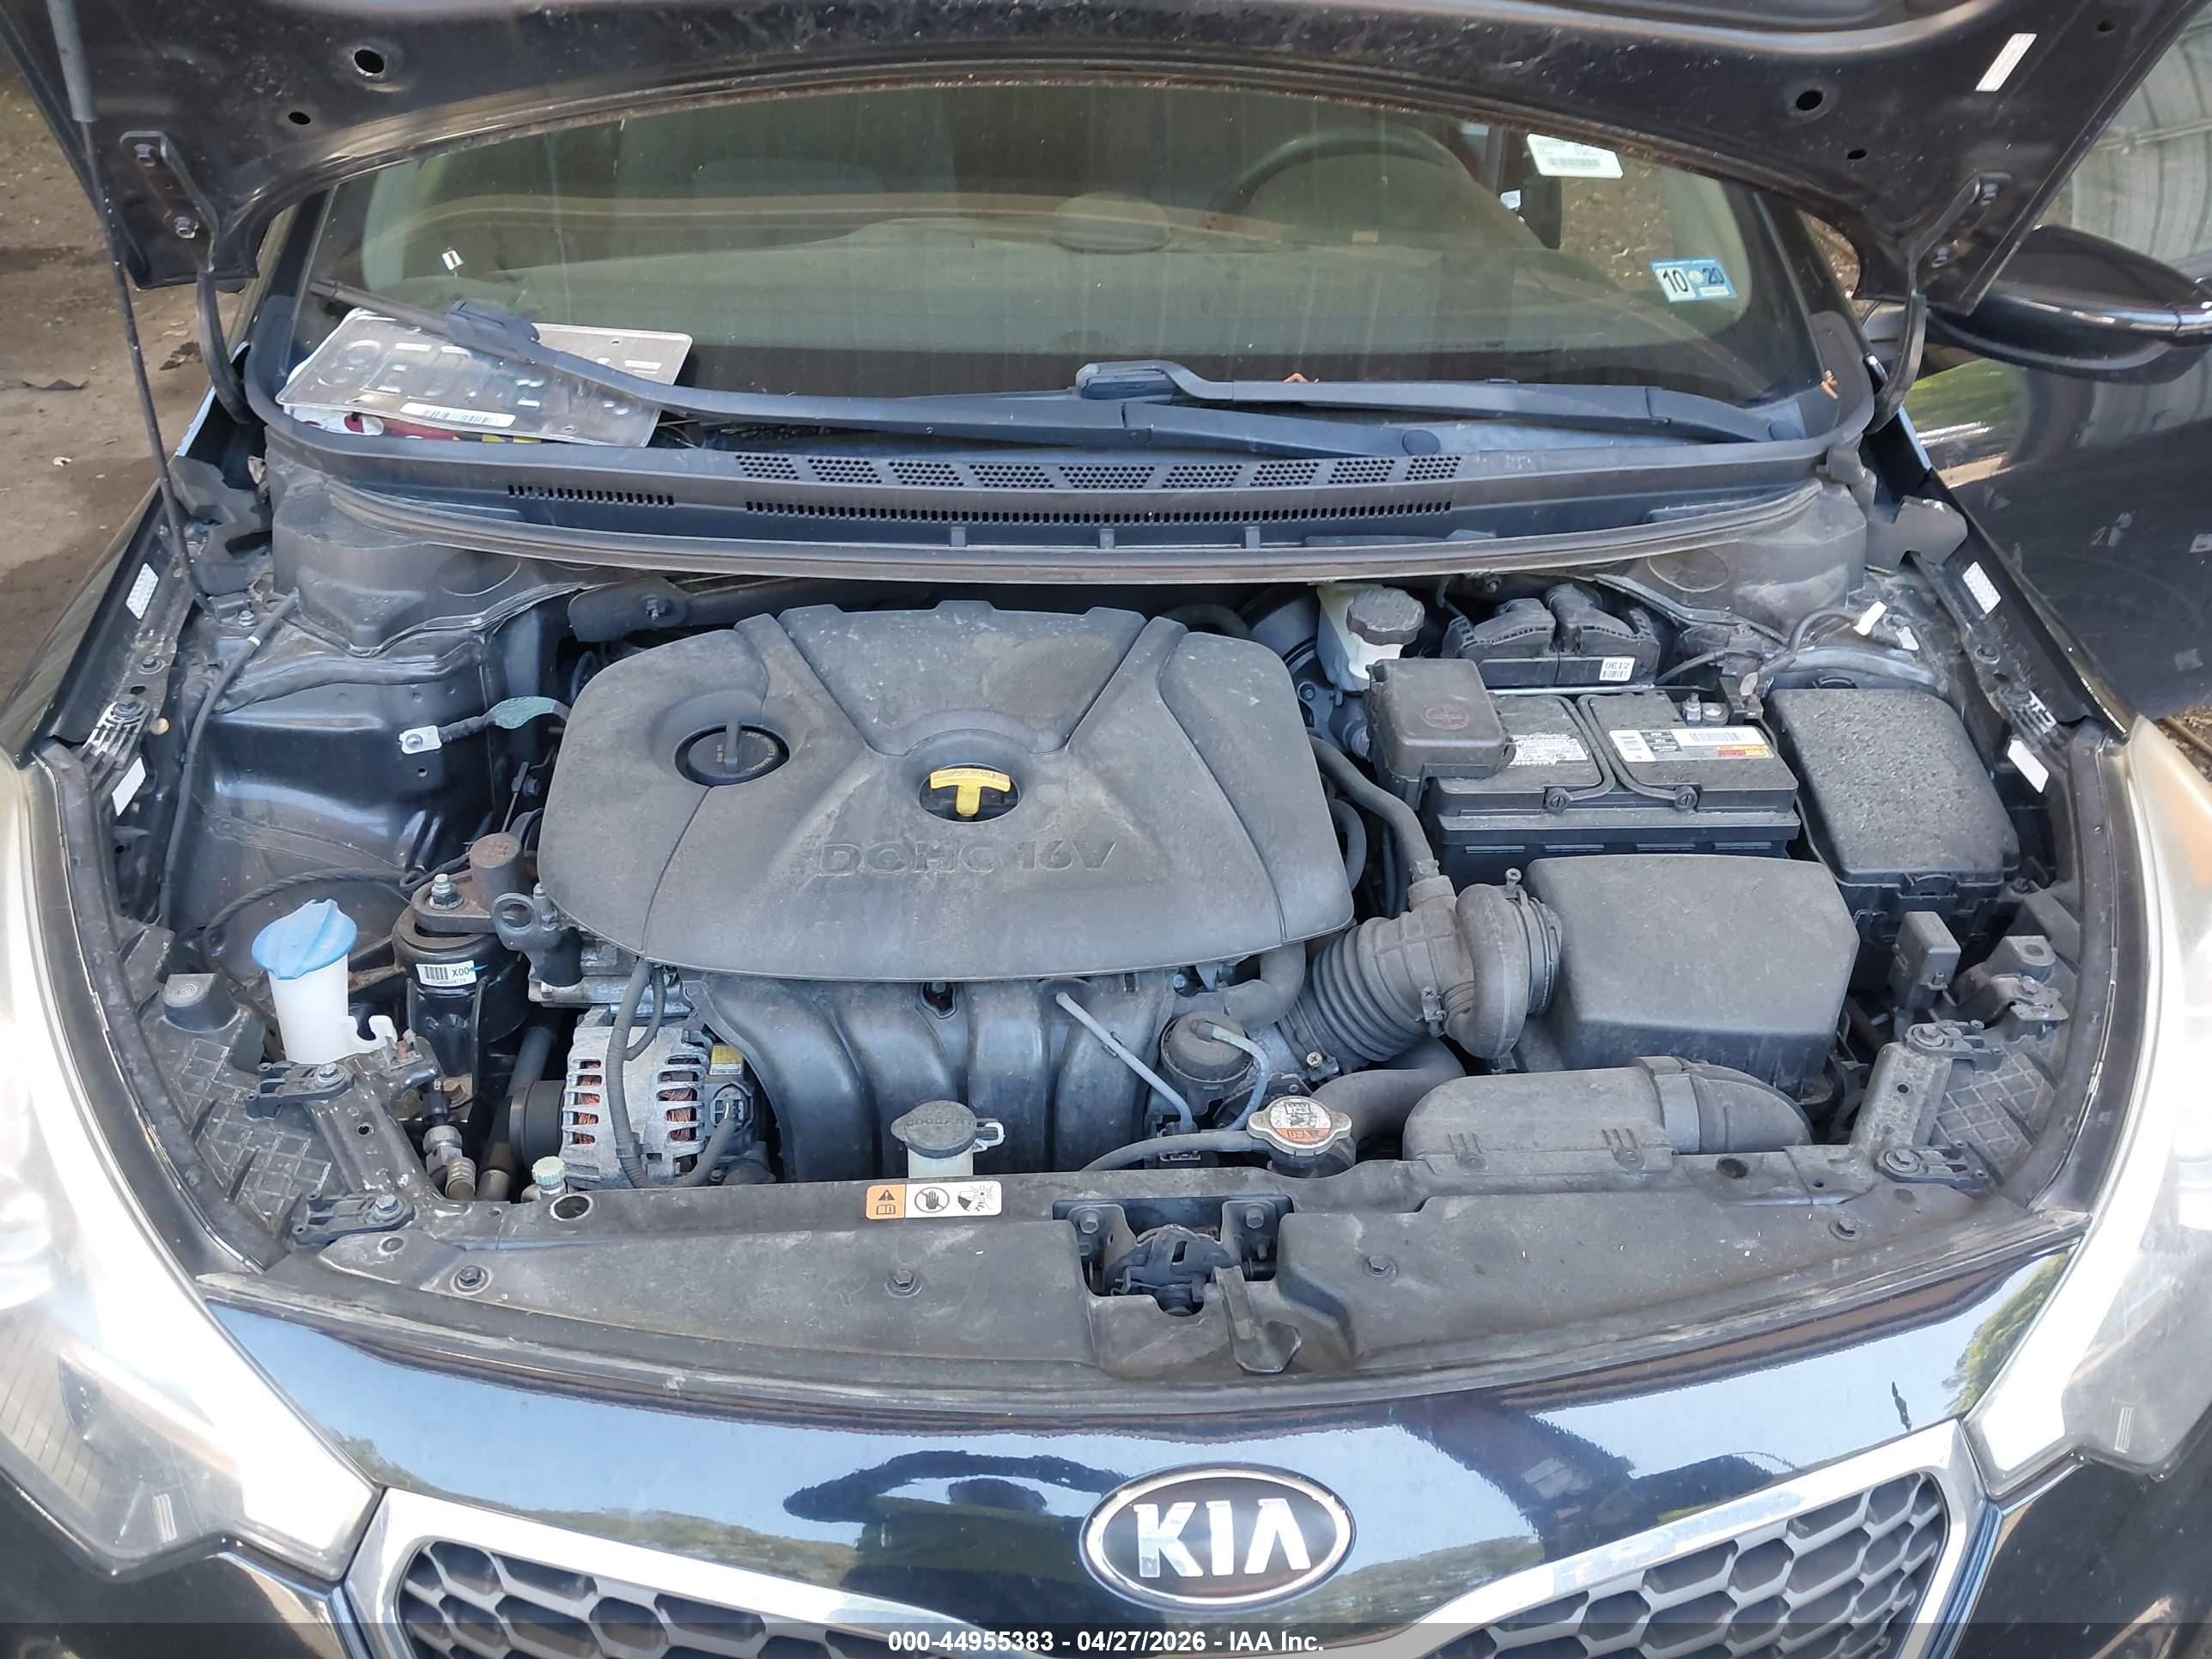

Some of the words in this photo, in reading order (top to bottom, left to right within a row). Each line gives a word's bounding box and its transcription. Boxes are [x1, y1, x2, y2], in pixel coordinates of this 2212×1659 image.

[1662, 269, 1689, 293] 10
[1702, 267, 1725, 285] 20
[817, 841, 995, 877] DOHC
[1015, 839, 1117, 872] 16V
[1133, 1497, 1312, 1579] KIA
